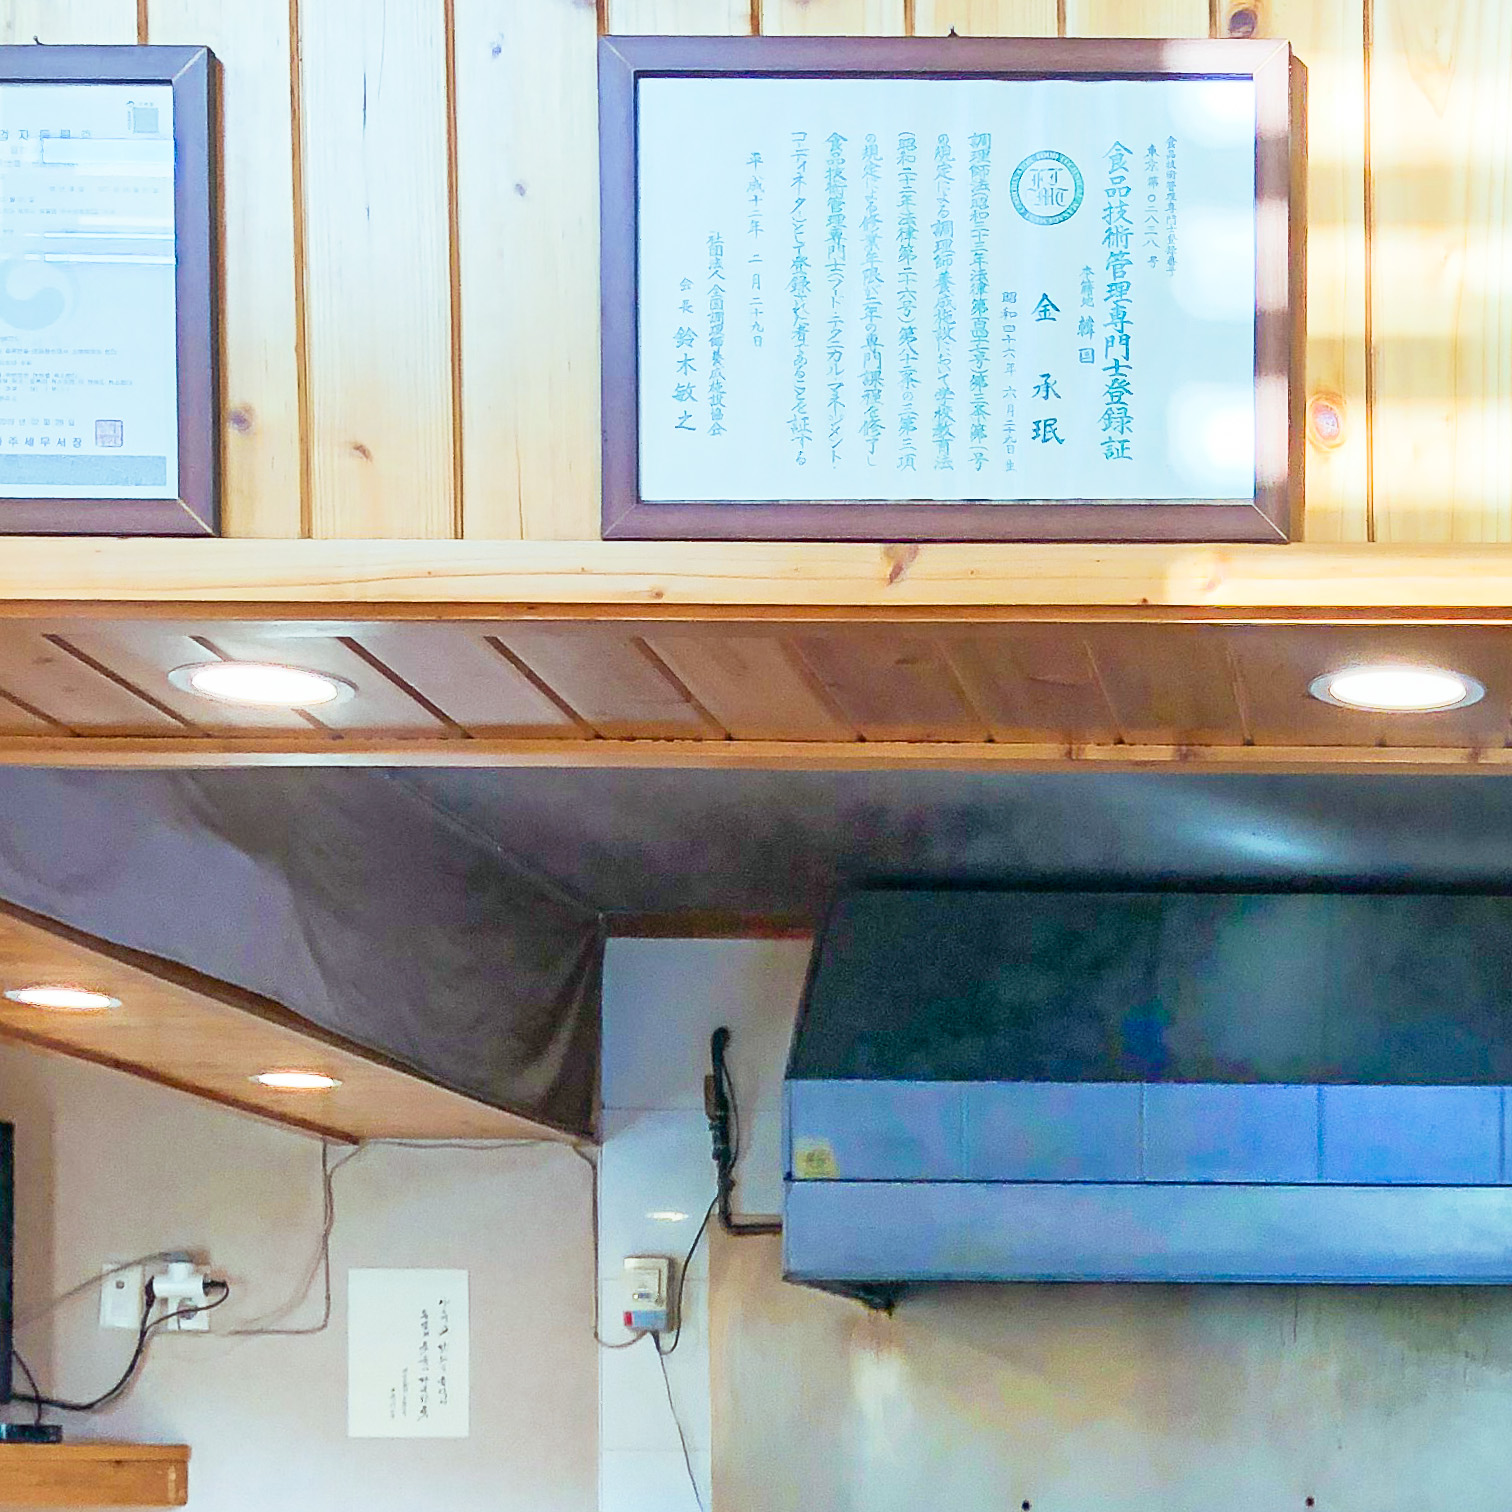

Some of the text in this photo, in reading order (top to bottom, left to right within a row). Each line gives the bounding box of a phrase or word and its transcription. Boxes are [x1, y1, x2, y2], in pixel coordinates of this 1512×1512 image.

[1031, 292, 1061, 322] 金
[1098, 140, 1135, 461] 食品技術管理専門士登録証
[671, 325, 698, 431] 鈴木敏之
[0, 435, 82, 448] 주세무서장
